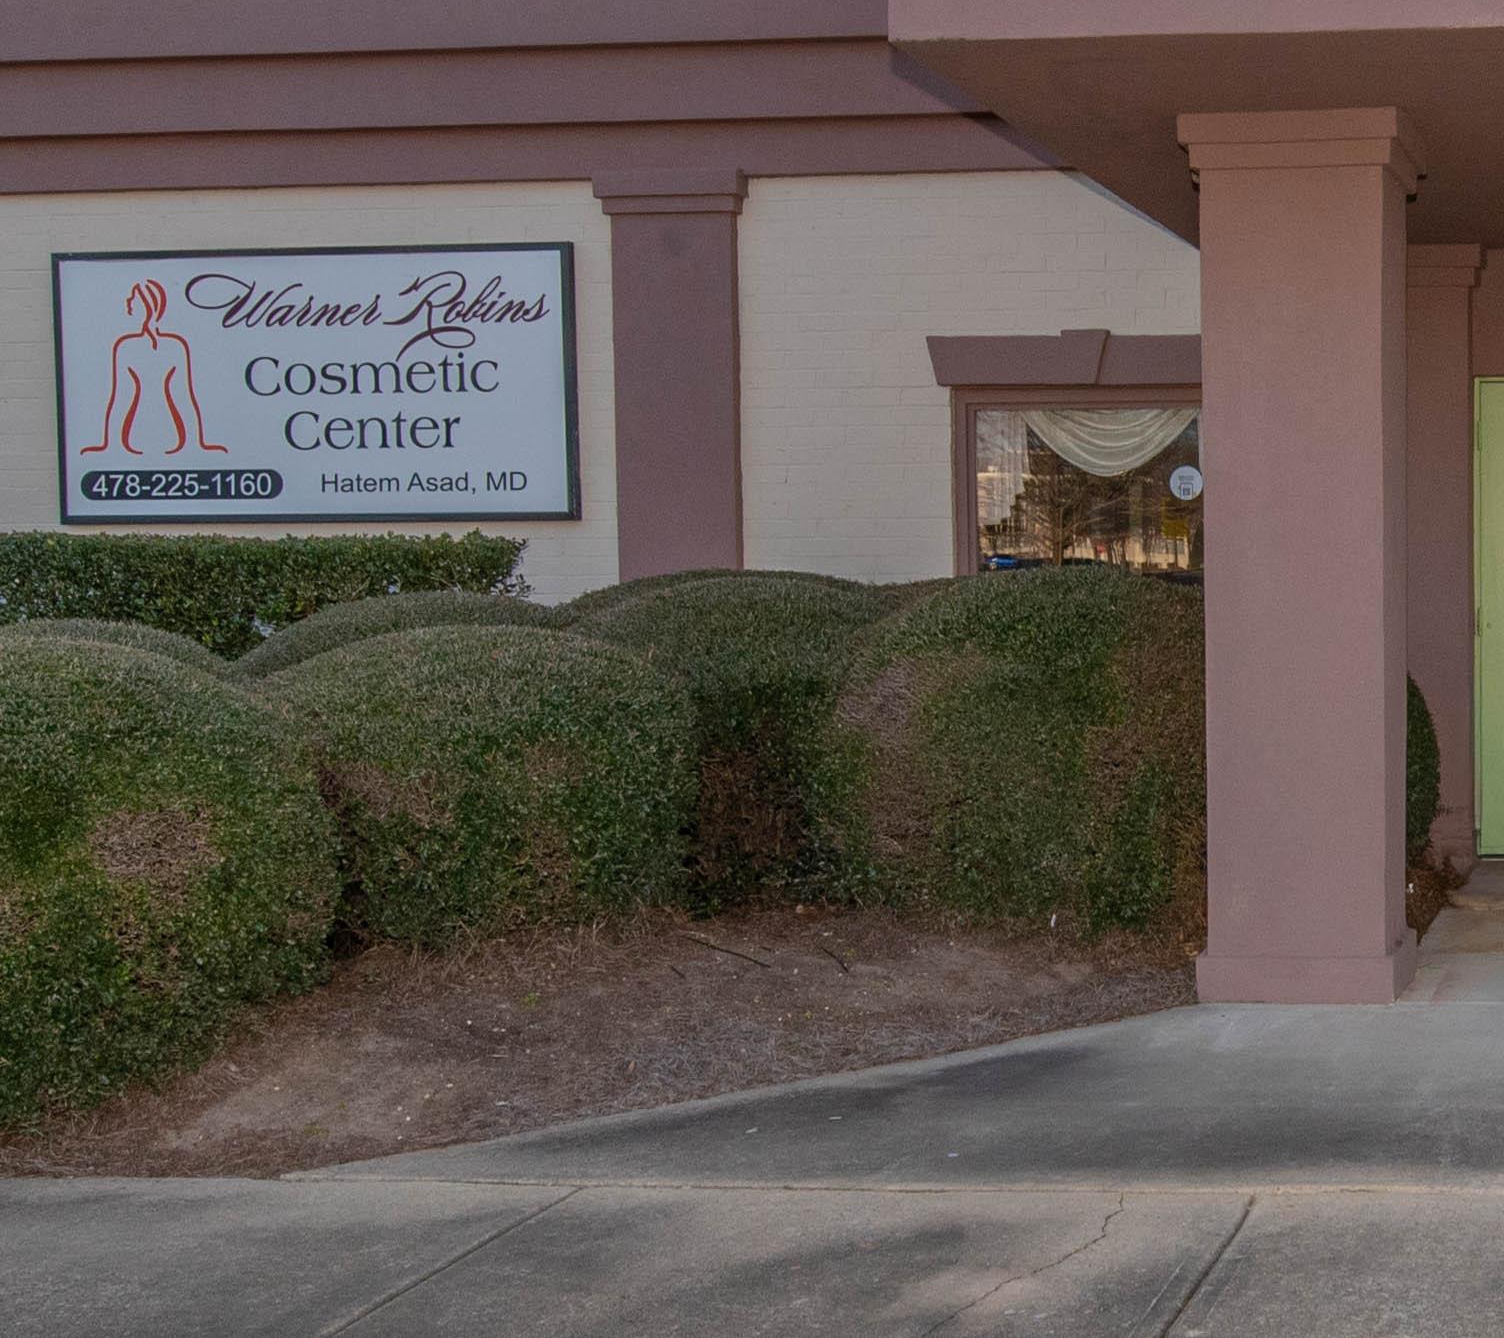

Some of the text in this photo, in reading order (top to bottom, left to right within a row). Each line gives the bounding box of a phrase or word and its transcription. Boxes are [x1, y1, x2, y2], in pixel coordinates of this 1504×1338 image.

[185, 270, 550, 351] Warner Robins
[244, 352, 499, 396] Cosmetic
[284, 410, 460, 451] Center
[91, 474, 272, 498] 478-225-1160
[321, 471, 527, 496] Hatem Asad, MD
